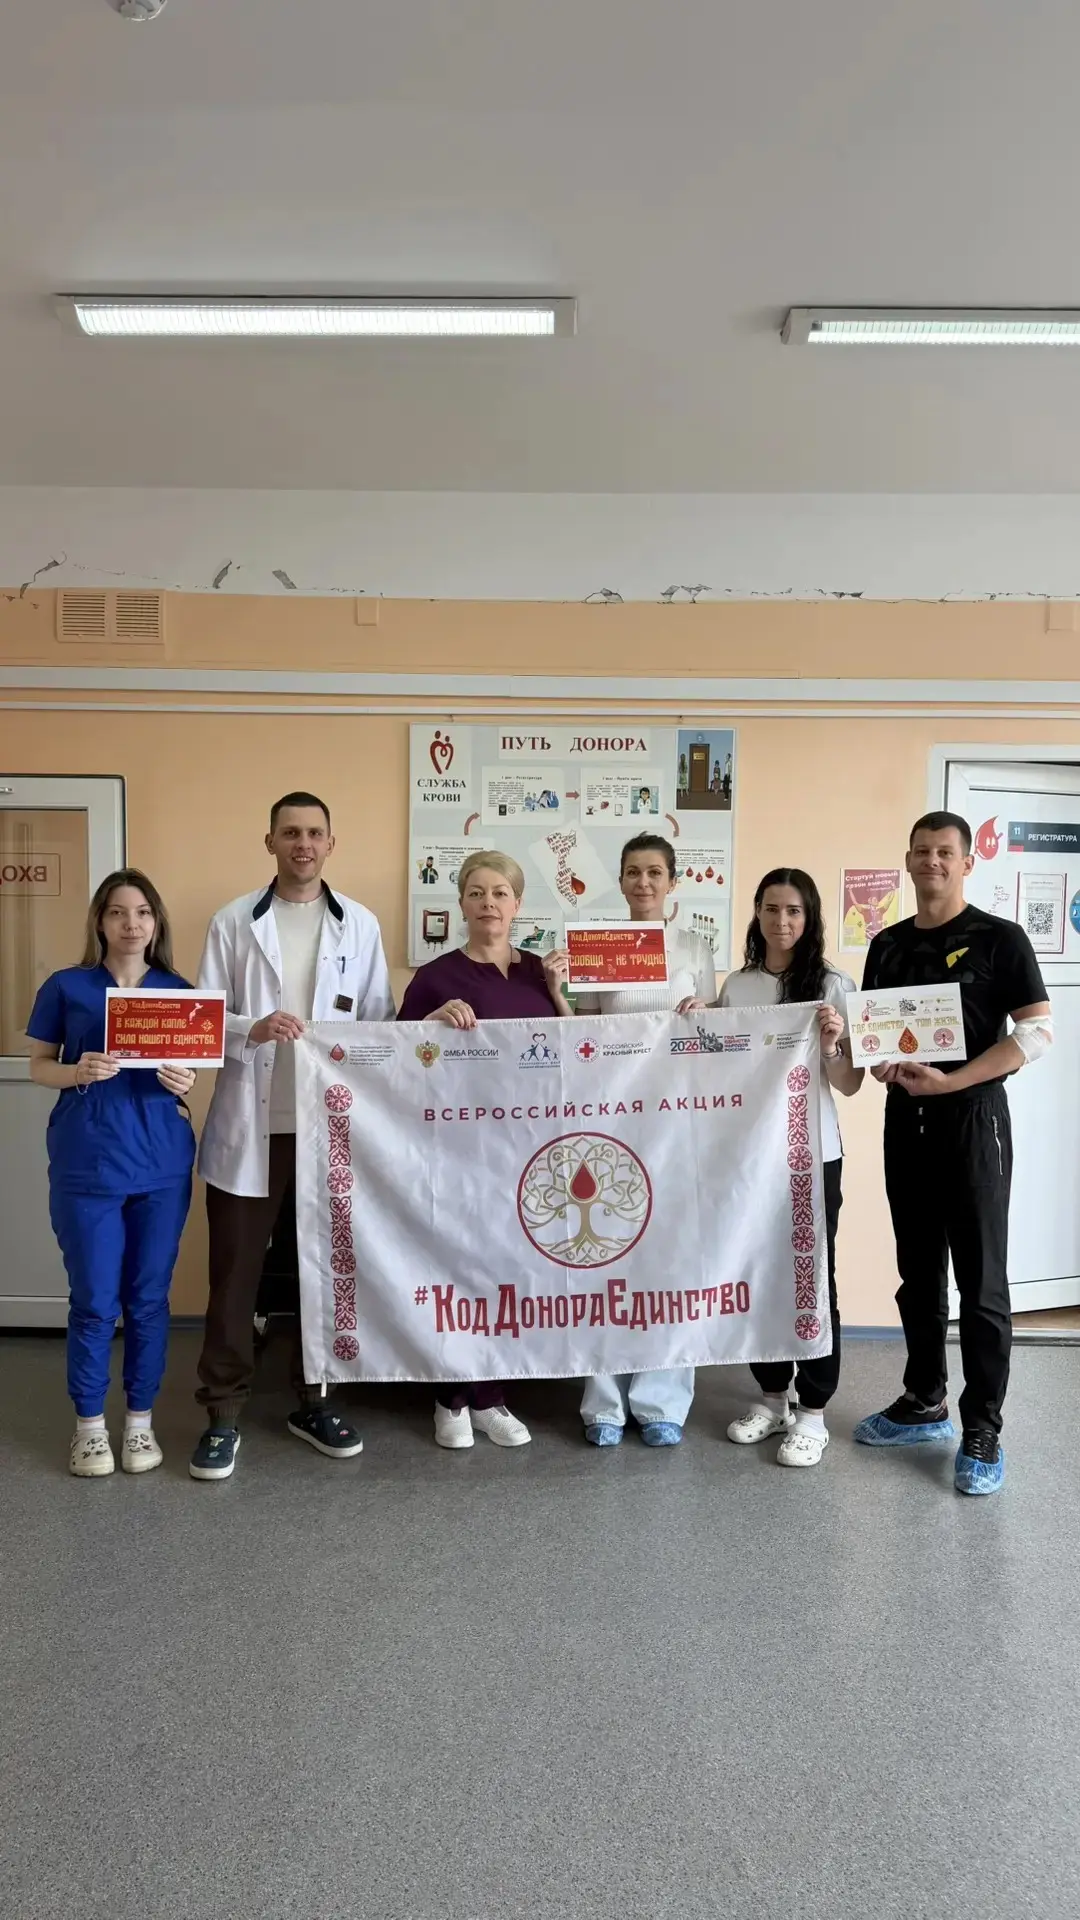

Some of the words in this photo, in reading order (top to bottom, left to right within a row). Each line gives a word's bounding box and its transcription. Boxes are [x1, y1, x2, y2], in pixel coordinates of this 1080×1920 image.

[501, 736, 552, 750] ПУТЬ
[570, 737, 647, 752] ДОНОРА
[417, 778, 466, 788] СЛУЖБА
[423, 793, 461, 802] КРОВИ
[1014, 827, 1021, 835] 11
[1028, 833, 1077, 842] РЕГИСТРАТУРА
[570, 954, 604, 968] СООБЩА
[616, 954, 627, 965] НЕ
[116, 1018, 122, 1028] В
[125, 1016, 158, 1030] КАЖДОЙ
[161, 1018, 186, 1029] КАПЛЕ
[116, 1034, 136, 1044] СИЛА
[138, 1034, 170, 1044] НАШЕГО
[173, 1034, 216, 1046] ЕДИНСТВА.
[603, 1041, 644, 1050] РОССИЙСКИЙ
[670, 1040, 699, 1052] 2026
[424, 1100, 643, 1121] ВСЕРОССИЙСКАЯ
[659, 1094, 742, 1111] АКЦИЯ
[415, 1278, 750, 1338] #КодДонораЕдинство
